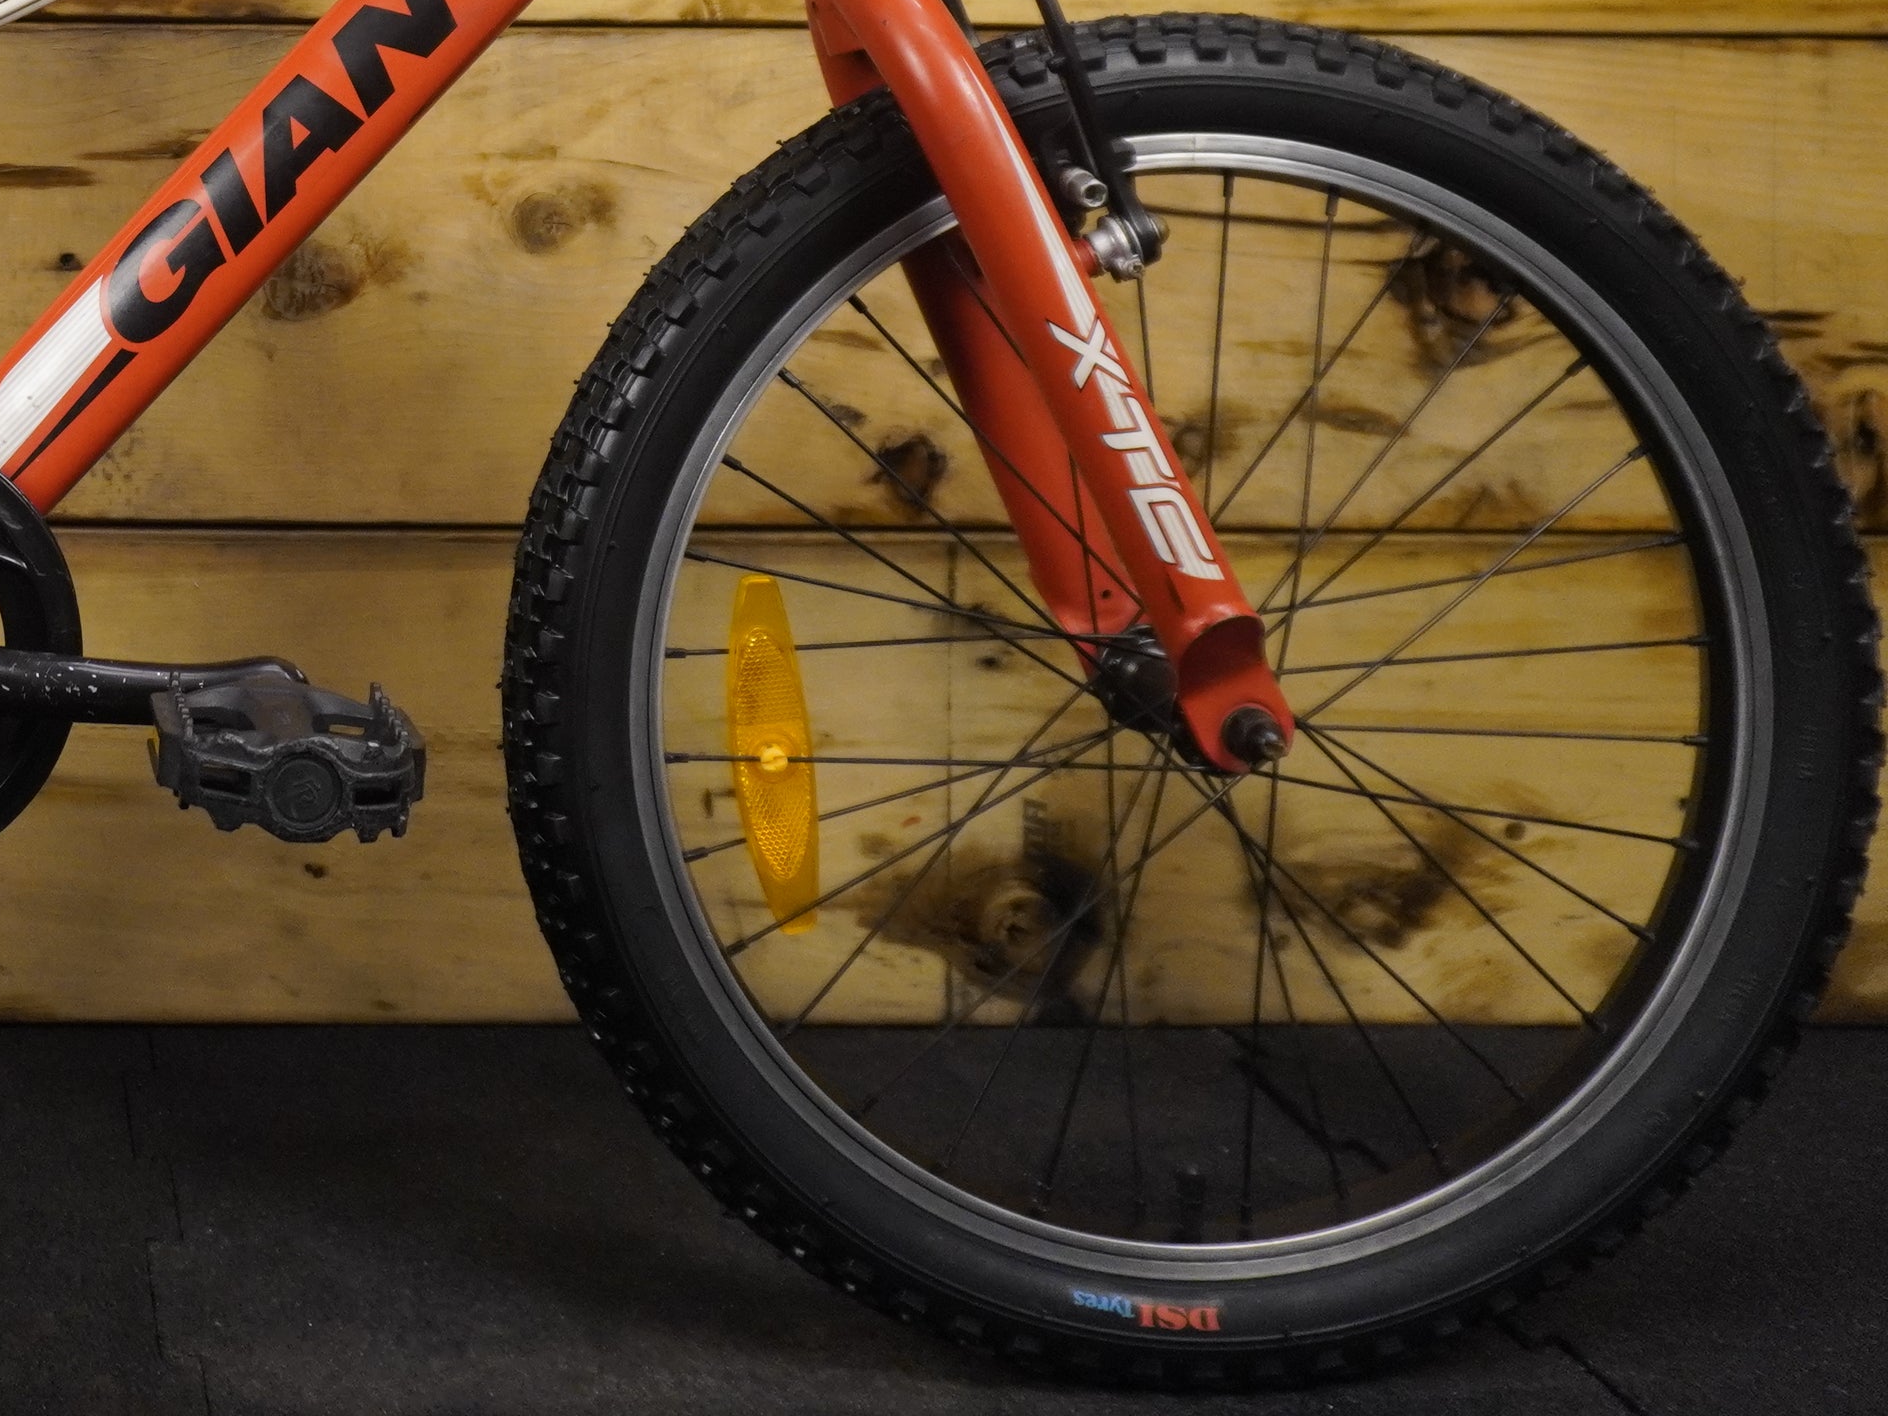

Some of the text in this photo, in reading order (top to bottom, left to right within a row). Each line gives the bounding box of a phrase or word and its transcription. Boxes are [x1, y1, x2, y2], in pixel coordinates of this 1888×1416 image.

[1046, 316, 1215, 564] XTC
[1071, 1288, 1221, 1332] DSI Tyres
